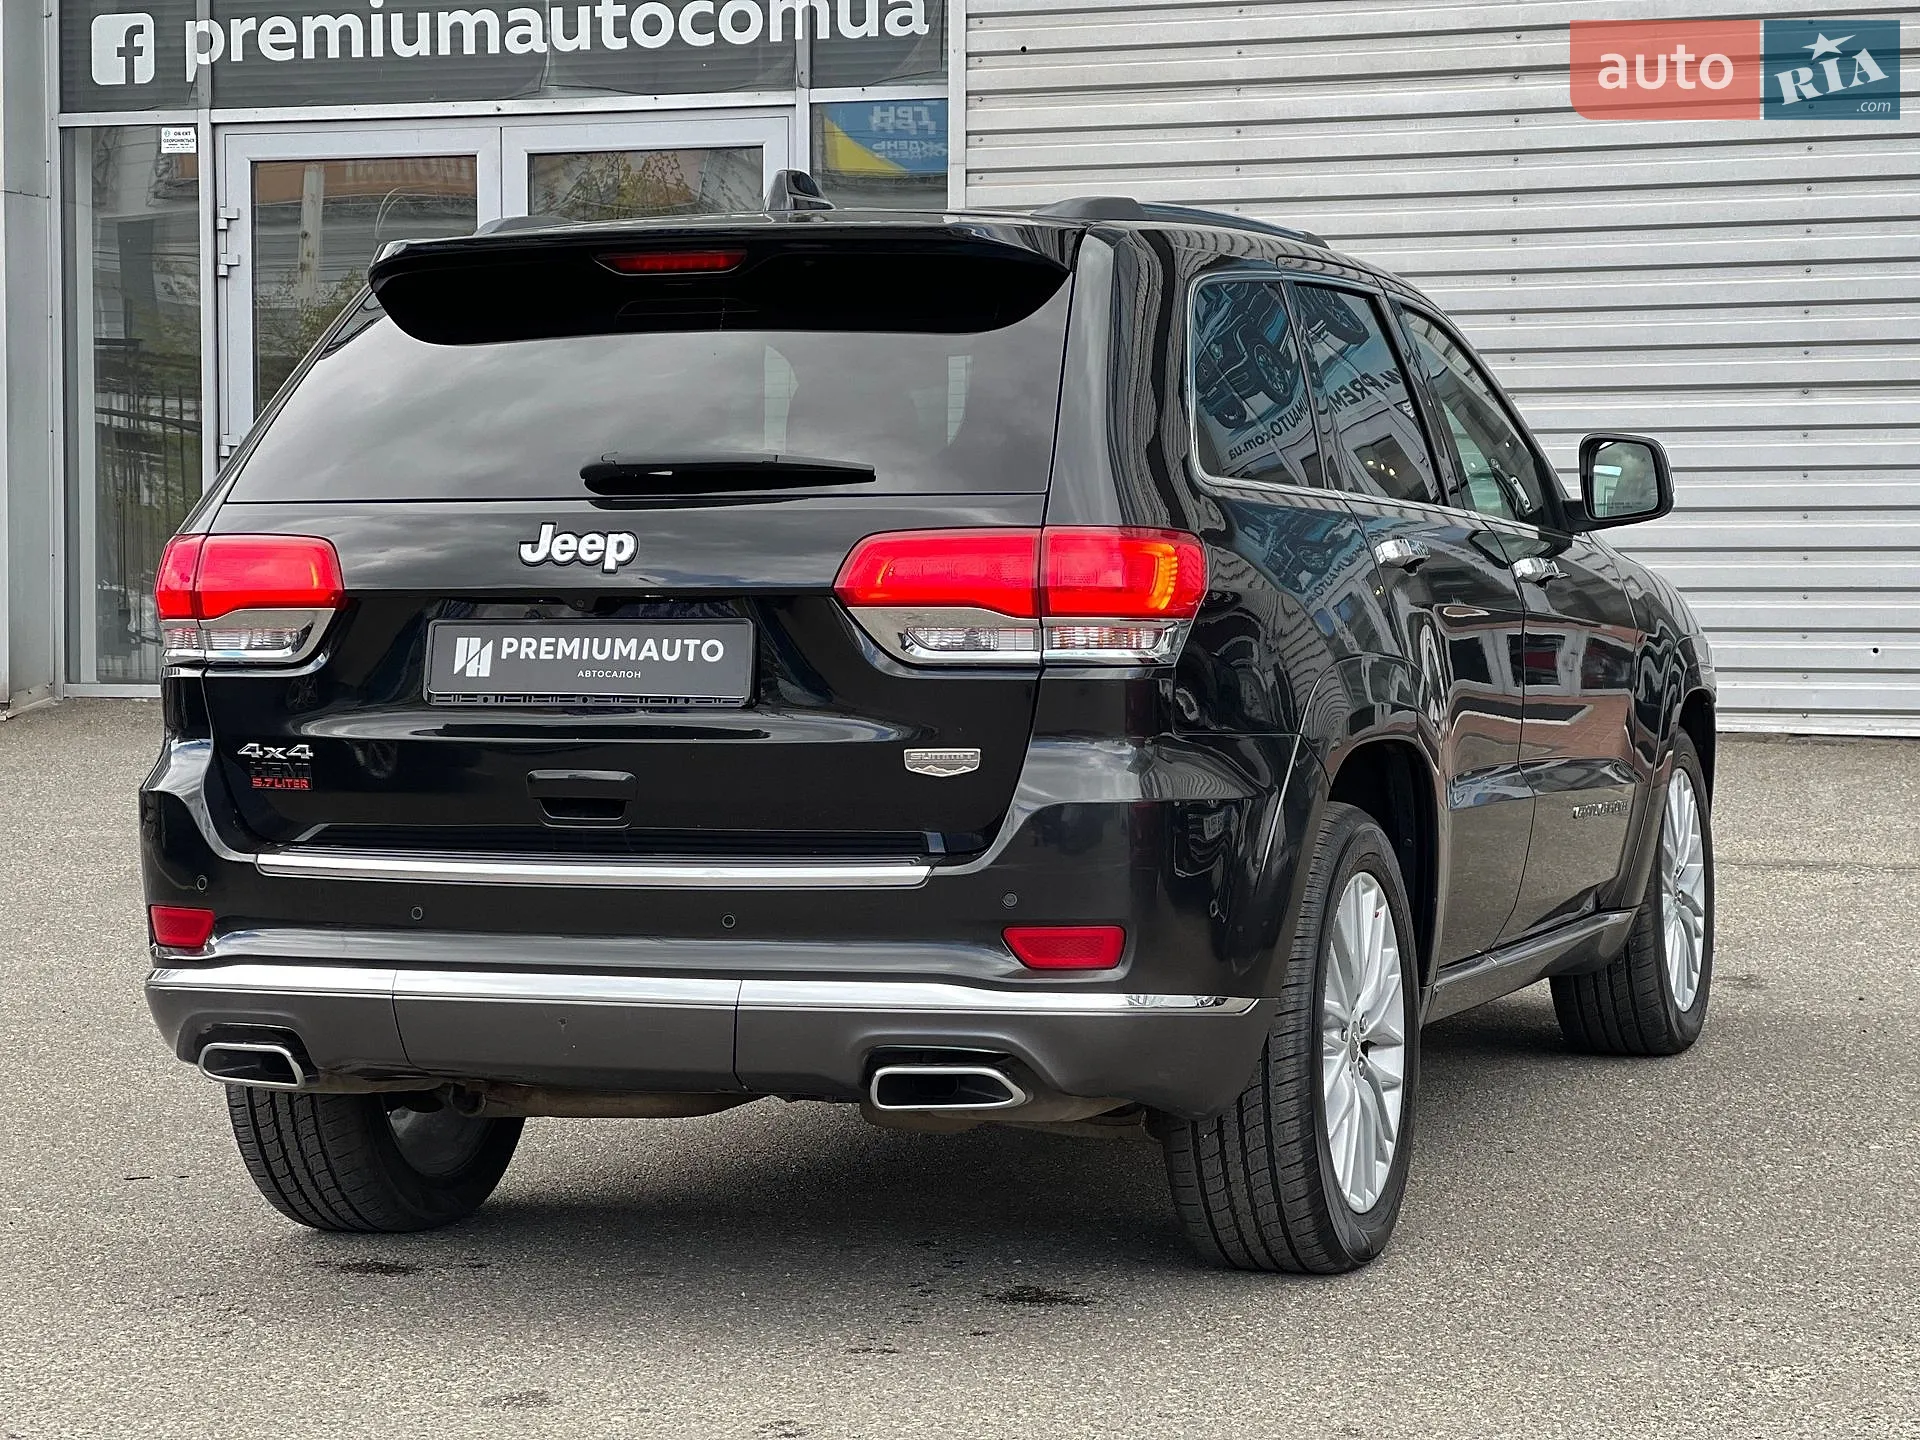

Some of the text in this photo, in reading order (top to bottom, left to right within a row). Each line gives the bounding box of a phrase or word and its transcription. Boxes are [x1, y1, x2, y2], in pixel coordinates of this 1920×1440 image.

[519, 522, 637, 571] Jeep
[500, 637, 725, 663] PREMIUMAUTO
[577, 669, 641, 680] АВТОСАЛОН
[237, 743, 314, 759] 4x4
[252, 777, 309, 789] 5.7 LITER
